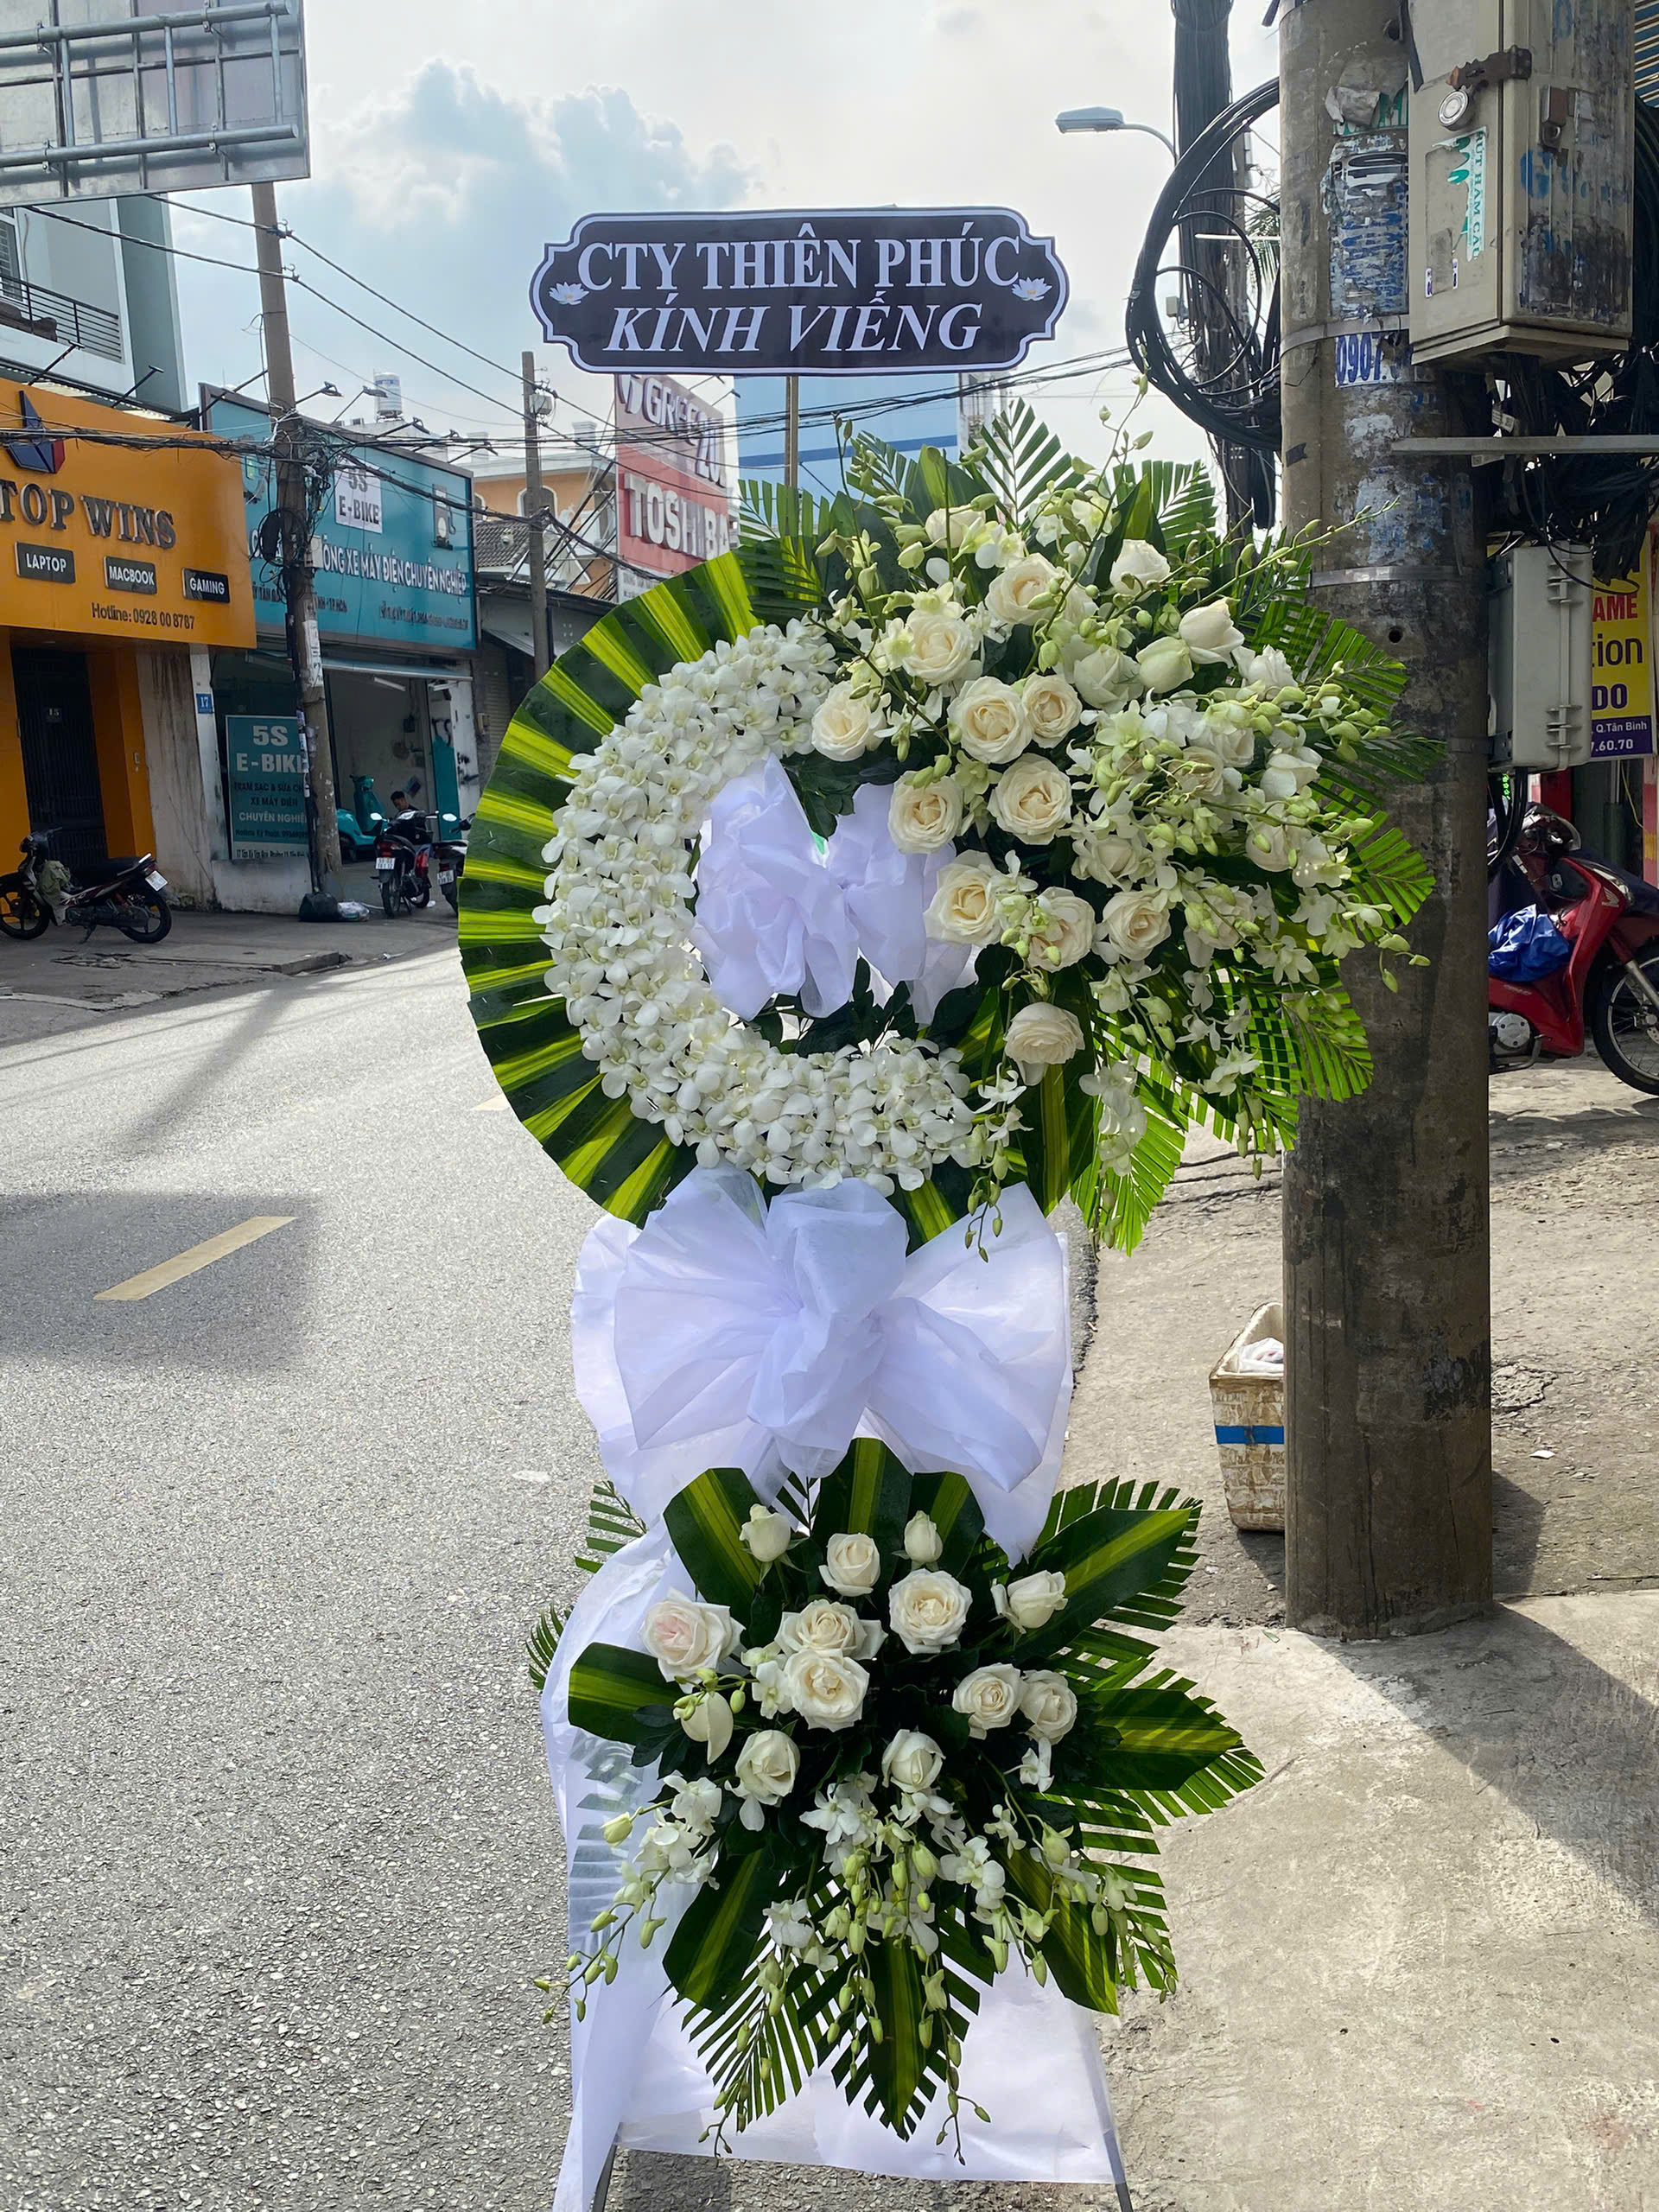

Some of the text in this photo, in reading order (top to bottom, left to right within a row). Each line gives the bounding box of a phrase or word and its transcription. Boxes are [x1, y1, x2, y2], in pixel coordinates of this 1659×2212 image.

[577, 221, 1022, 290] CTY THIÊN PHÚC
[602, 290, 983, 353] KÍNH VIẾNG
[80, 495, 176, 550] WINS
[624, 474, 729, 562] TOSHIBA
[26, 553, 67, 573] LAPTOP
[109, 565, 155, 586] MACBOOK
[189, 578, 226, 595] GAMING
[92, 602, 131, 623] Hotline:
[133, 608, 157, 626] 0928
[173, 613, 195, 630] 8787
[1592, 593, 1638, 622] AME
[1592, 633, 1643, 667] ion
[200, 696, 209, 708] 17
[252, 725, 289, 747] 5S
